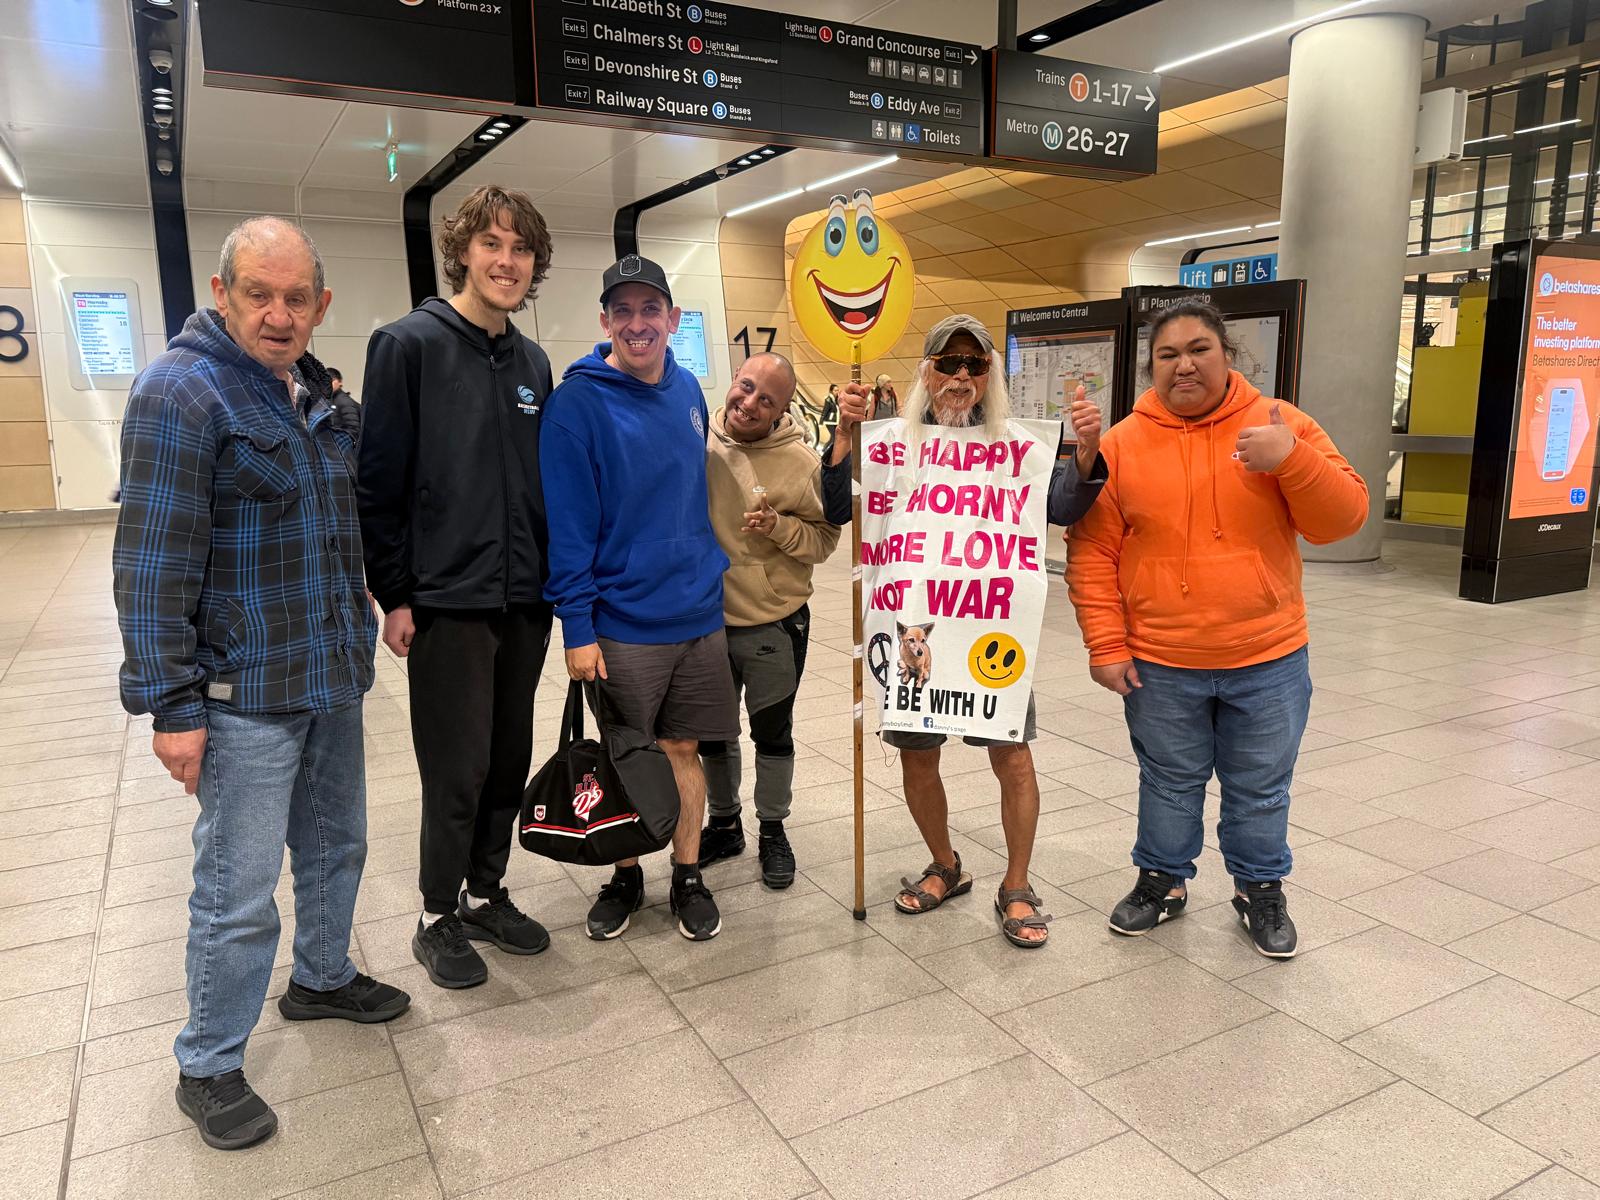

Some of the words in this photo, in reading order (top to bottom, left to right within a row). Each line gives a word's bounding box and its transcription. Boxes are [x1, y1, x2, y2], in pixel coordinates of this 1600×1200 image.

[437, 0, 478, 11] Platform
[480, 3, 492, 13] 23
[667, 2, 682, 19] St
[704, 8, 727, 20] Buses
[564, 23, 579, 32] Exit
[580, 25, 586, 33] 5
[784, 22, 803, 33] Light
[804, 24, 817, 34] Rail
[593, 24, 665, 48] Chalmers
[668, 34, 684, 51] St
[705, 40, 724, 51] Light
[726, 43, 740, 52] Rail
[836, 30, 874, 49] Grand
[877, 37, 940, 59] Concourse
[946, 50, 956, 58] Exit
[566, 56, 581, 65] Exit
[595, 56, 680, 82] Devonshire
[683, 68, 698, 84] St
[720, 73, 742, 84] Buses
[568, 90, 581, 98] Exit
[850, 90, 868, 100] Buses
[1036, 69, 1065, 86] Trains
[1092, 79, 1132, 106] 1-17
[596, 89, 654, 113] Railway
[657, 96, 708, 116] Square
[730, 105, 751, 115] Buses
[888, 96, 917, 115] Eddy
[919, 101, 940, 115] Ave
[946, 106, 956, 114] Exit
[923, 128, 960, 145] Toilets
[1006, 118, 1038, 135] Metro
[1066, 126, 1130, 156] 26-27
[1184, 270, 1207, 288] Lift
[1554, 278, 1600, 295] betashares
[1151, 297, 1170, 309] Plan
[1020, 310, 1051, 322] Welcome
[1052, 308, 1060, 319] to
[1061, 306, 1088, 318] Central
[1537, 316, 1551, 330] The
[1552, 317, 1577, 331] better
[733, 326, 777, 360] 17
[1534, 336, 1569, 351] investing
[1533, 354, 1576, 367] Betashares
[868, 441, 906, 467] BE
[919, 438, 1034, 478] HAPPY
[868, 490, 898, 516] BE
[906, 483, 1031, 526] HORNY
[1538, 523, 1561, 532] JCDecaux
[862, 532, 926, 566] MORE
[941, 531, 1039, 572] LOVE
[870, 579, 912, 612] NOT
[926, 576, 1015, 619] WAR
[897, 685, 922, 712] BE
[930, 688, 975, 717] WITH
[983, 694, 997, 720] U
